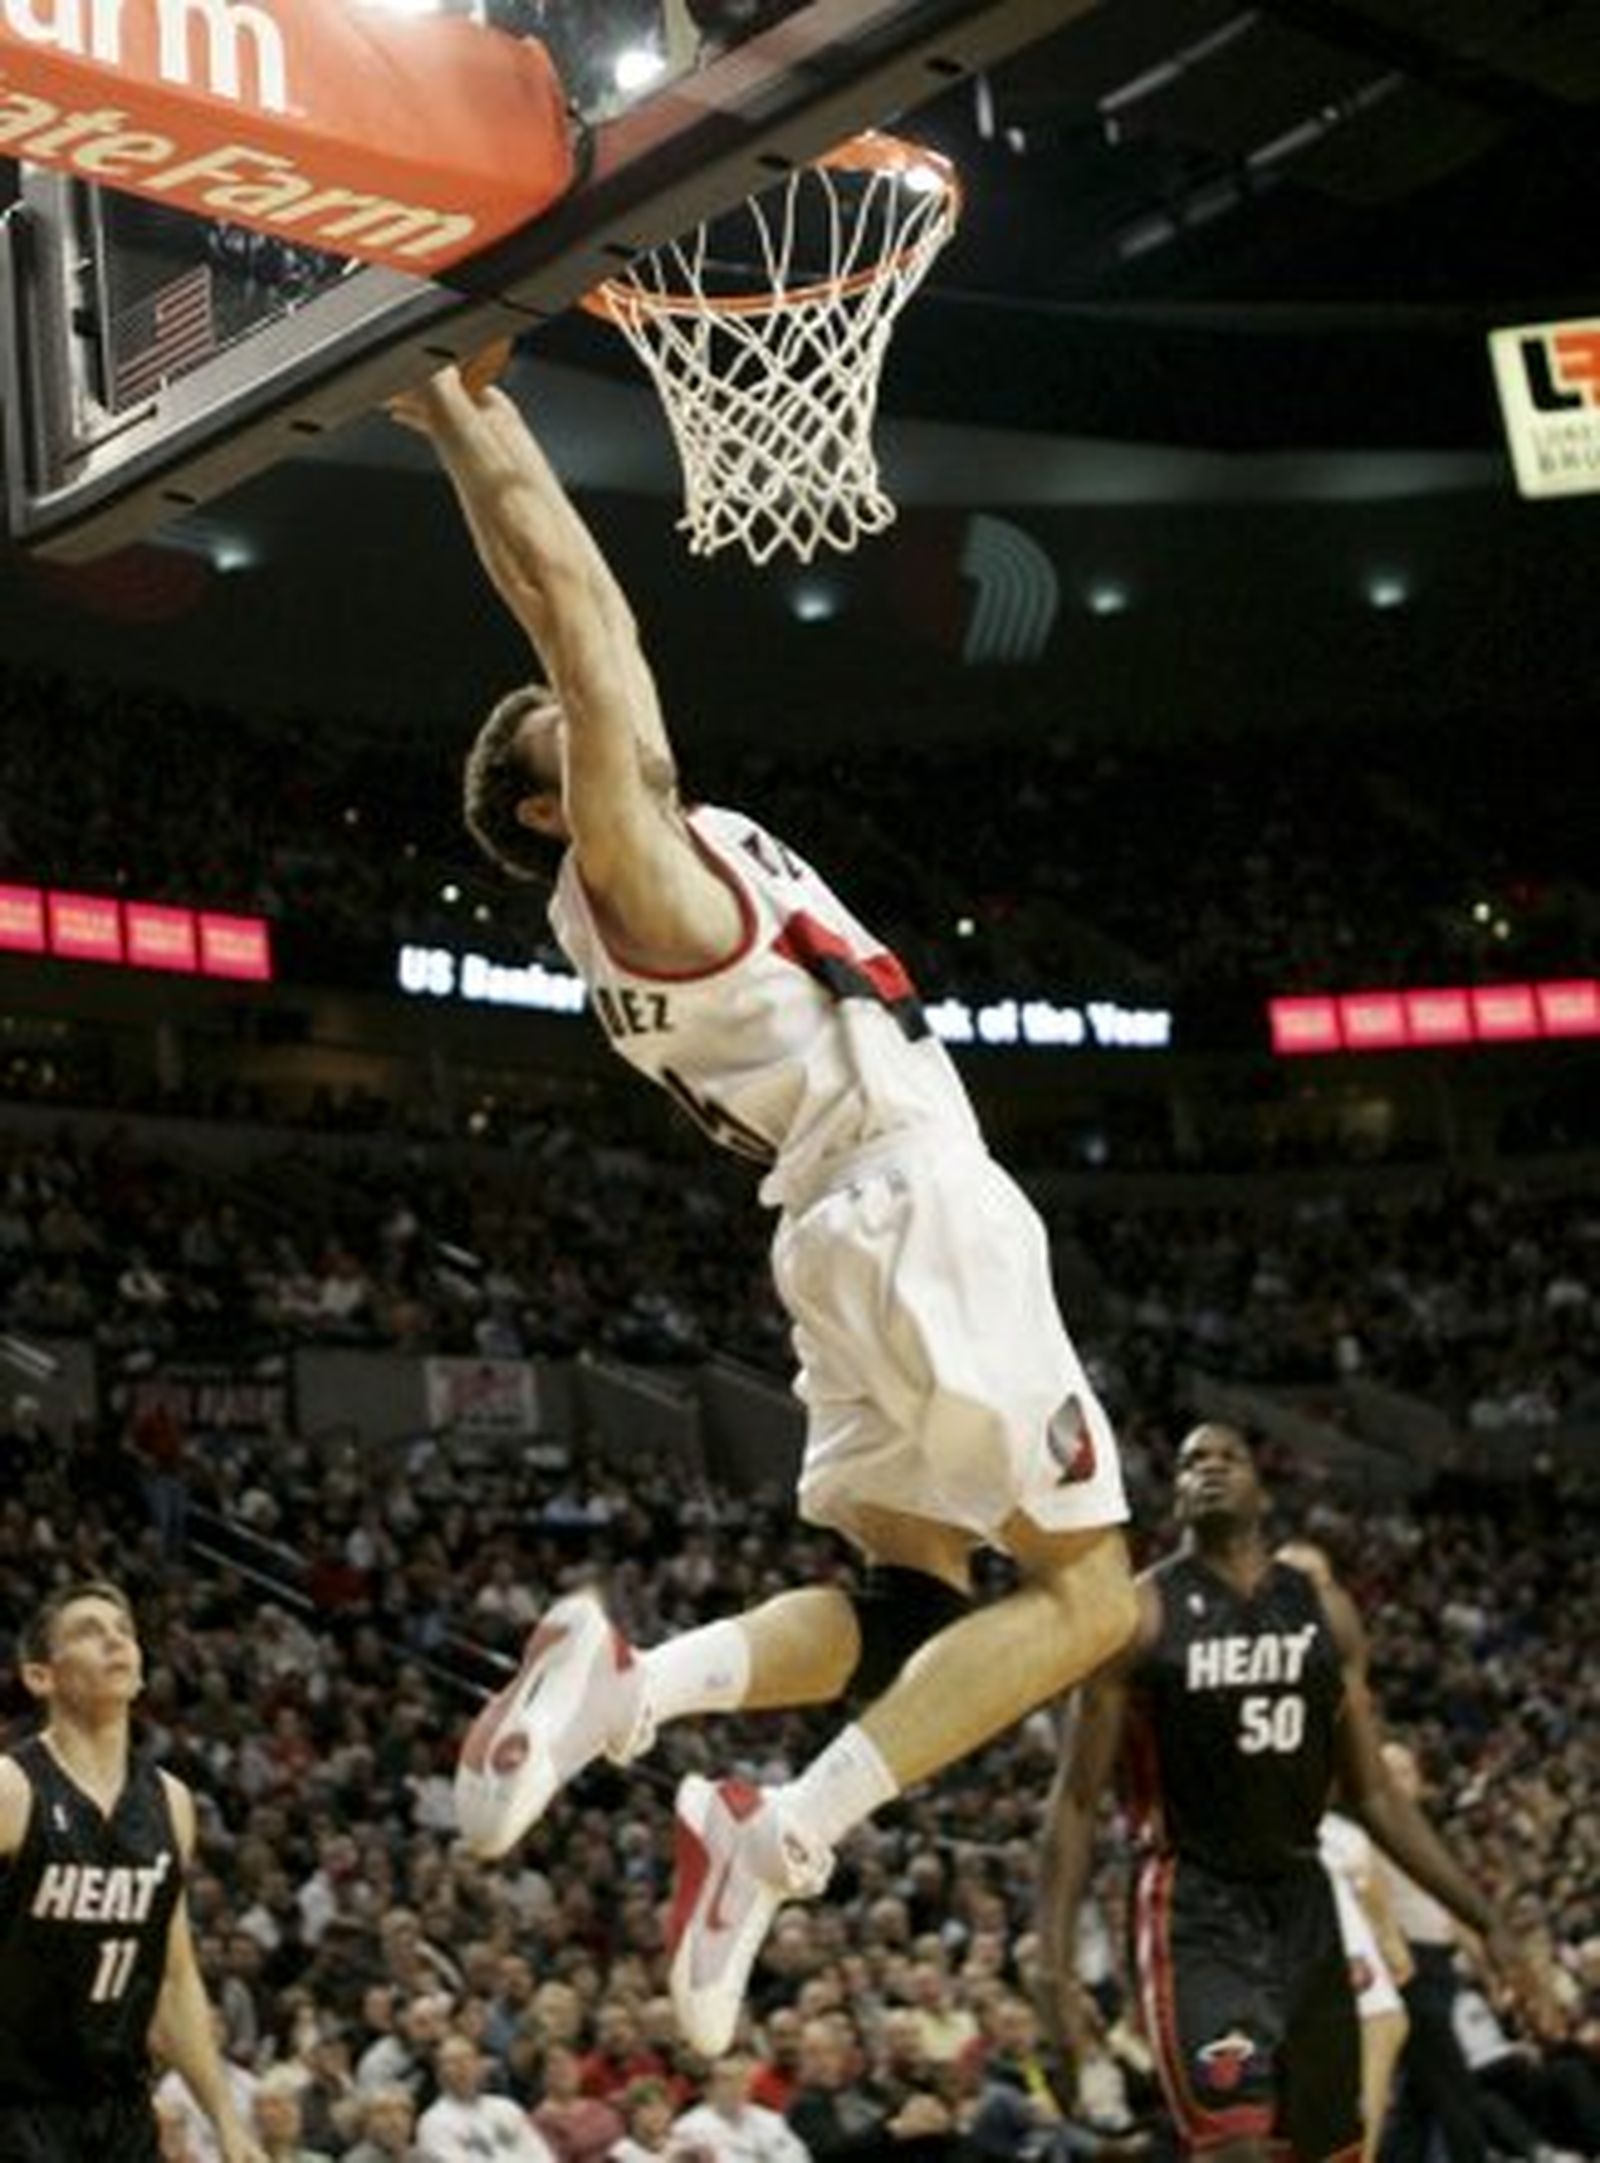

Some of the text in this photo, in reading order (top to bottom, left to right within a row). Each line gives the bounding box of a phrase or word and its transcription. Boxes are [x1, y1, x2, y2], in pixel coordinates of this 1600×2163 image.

[138, 144, 477, 258] Farm
[399, 945, 455, 996] US
[977, 999, 1018, 1044] of
[1022, 999, 1084, 1046] the
[1086, 1002, 1172, 1047] Year
[1185, 1621, 1319, 1692] HEAT
[1237, 1695, 1307, 1755] 50
[31, 1851, 173, 1924] HEAT
[90, 1937, 140, 2003] 11
